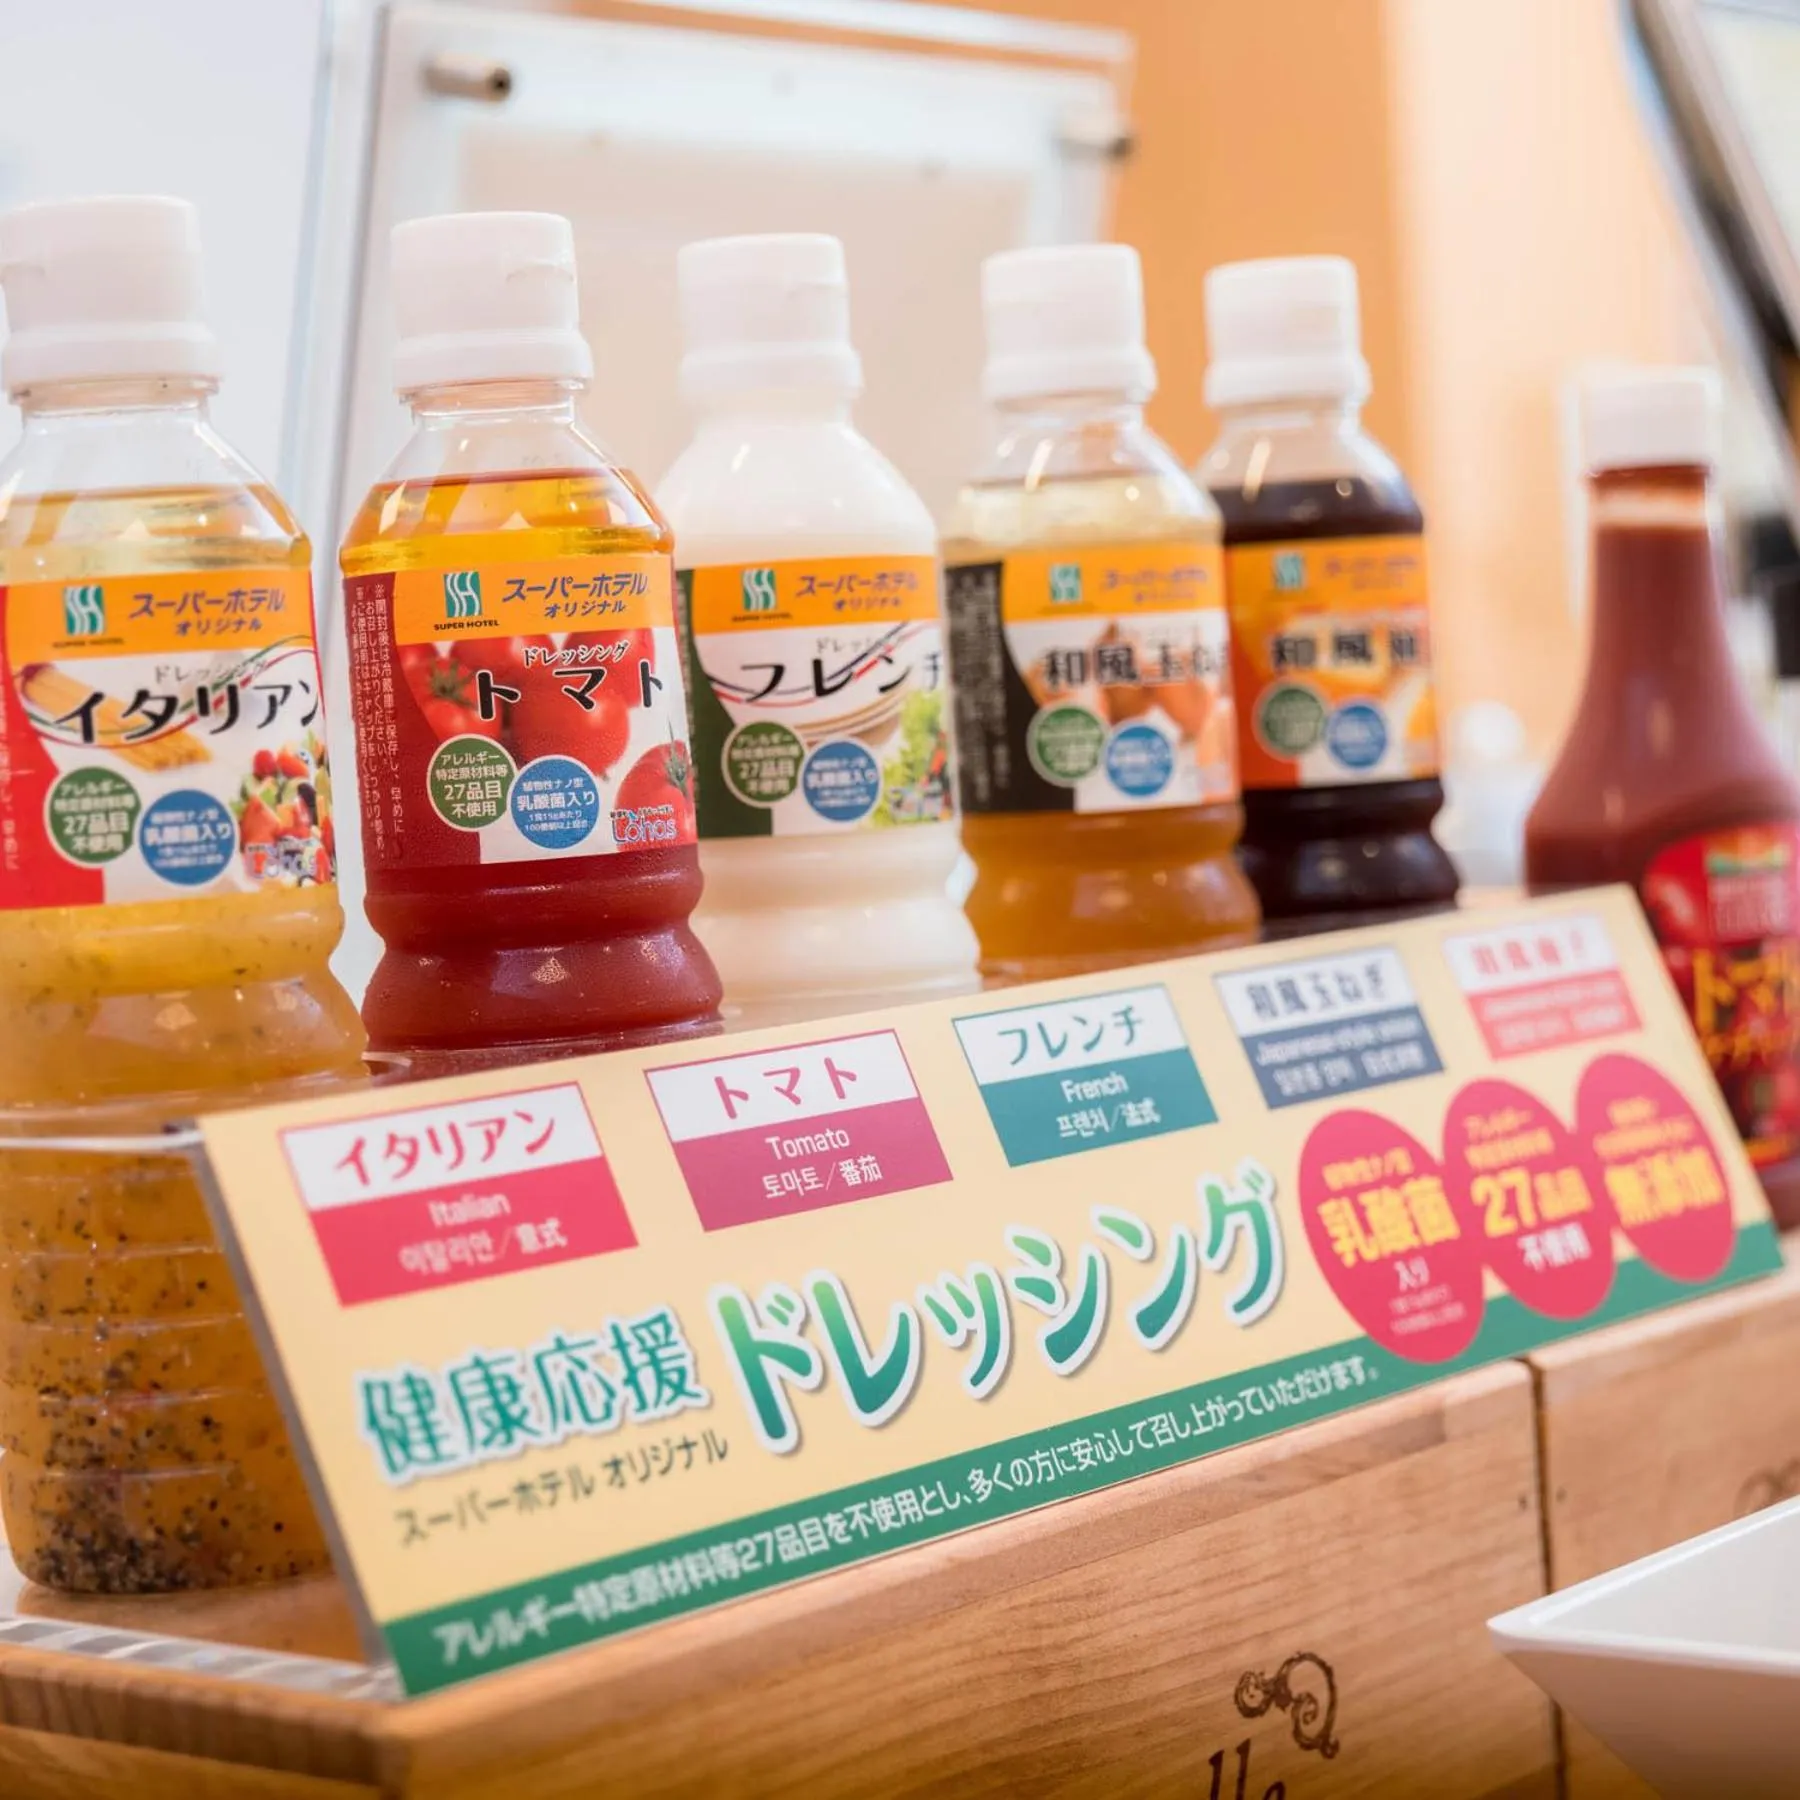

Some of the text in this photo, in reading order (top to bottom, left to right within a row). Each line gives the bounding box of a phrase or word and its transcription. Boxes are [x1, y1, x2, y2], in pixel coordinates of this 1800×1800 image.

[129, 588, 286, 620] スーパーホテル
[502, 572, 648, 603] スーパーホテル
[434, 618, 500, 631] SUPER HOTEL
[544, 601, 627, 619] オリジナル
[176, 618, 262, 636] オリジナル
[523, 641, 629, 667] ドレッシング
[477, 660, 663, 720] トマト
[740, 652, 941, 702] フレンチ
[54, 680, 319, 744] イタリアン
[436, 764, 508, 780] 特定原材料等
[441, 752, 500, 766] アレルギー
[444, 780, 502, 801] 27品目
[517, 791, 596, 812] 乳酸菌入り
[452, 802, 498, 818] 不使用
[997, 1005, 1145, 1067] フレンチ
[714, 1056, 858, 1120] トマト
[1060, 1071, 1129, 1104] French
[335, 1110, 556, 1187] イタリアン
[766, 1126, 850, 1161] Tomato
[428, 1193, 512, 1227] Italian
[714, 1165, 1280, 1444] ドレッシング
[359, 1311, 703, 1476] 健康応援
[395, 1428, 730, 1547] スーパーホテル オリジナル
